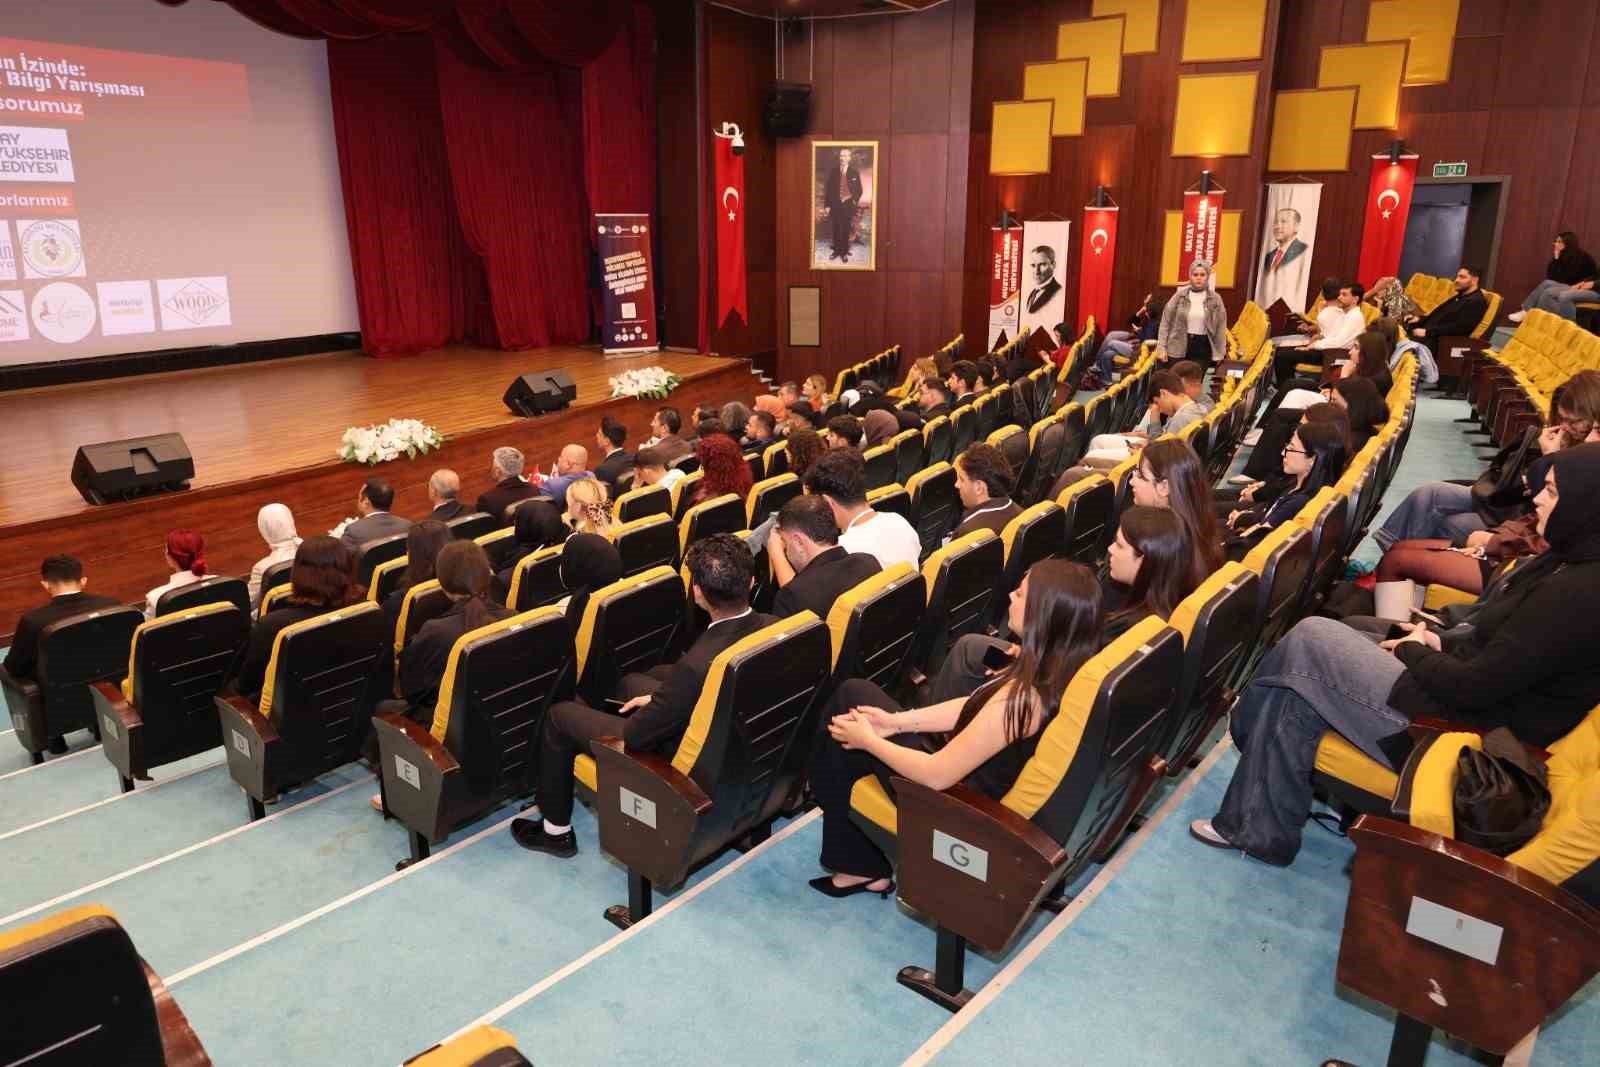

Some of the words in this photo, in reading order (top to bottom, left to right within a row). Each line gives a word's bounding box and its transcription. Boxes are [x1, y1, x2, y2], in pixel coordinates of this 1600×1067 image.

[20, 52, 86, 77] İzinde:
[6, 71, 52, 92] Bilgi
[55, 75, 145, 97] Yarışması
[1184, 222, 1195, 252] HATAY
[633, 797, 643, 816] F
[950, 843, 970, 867] G
